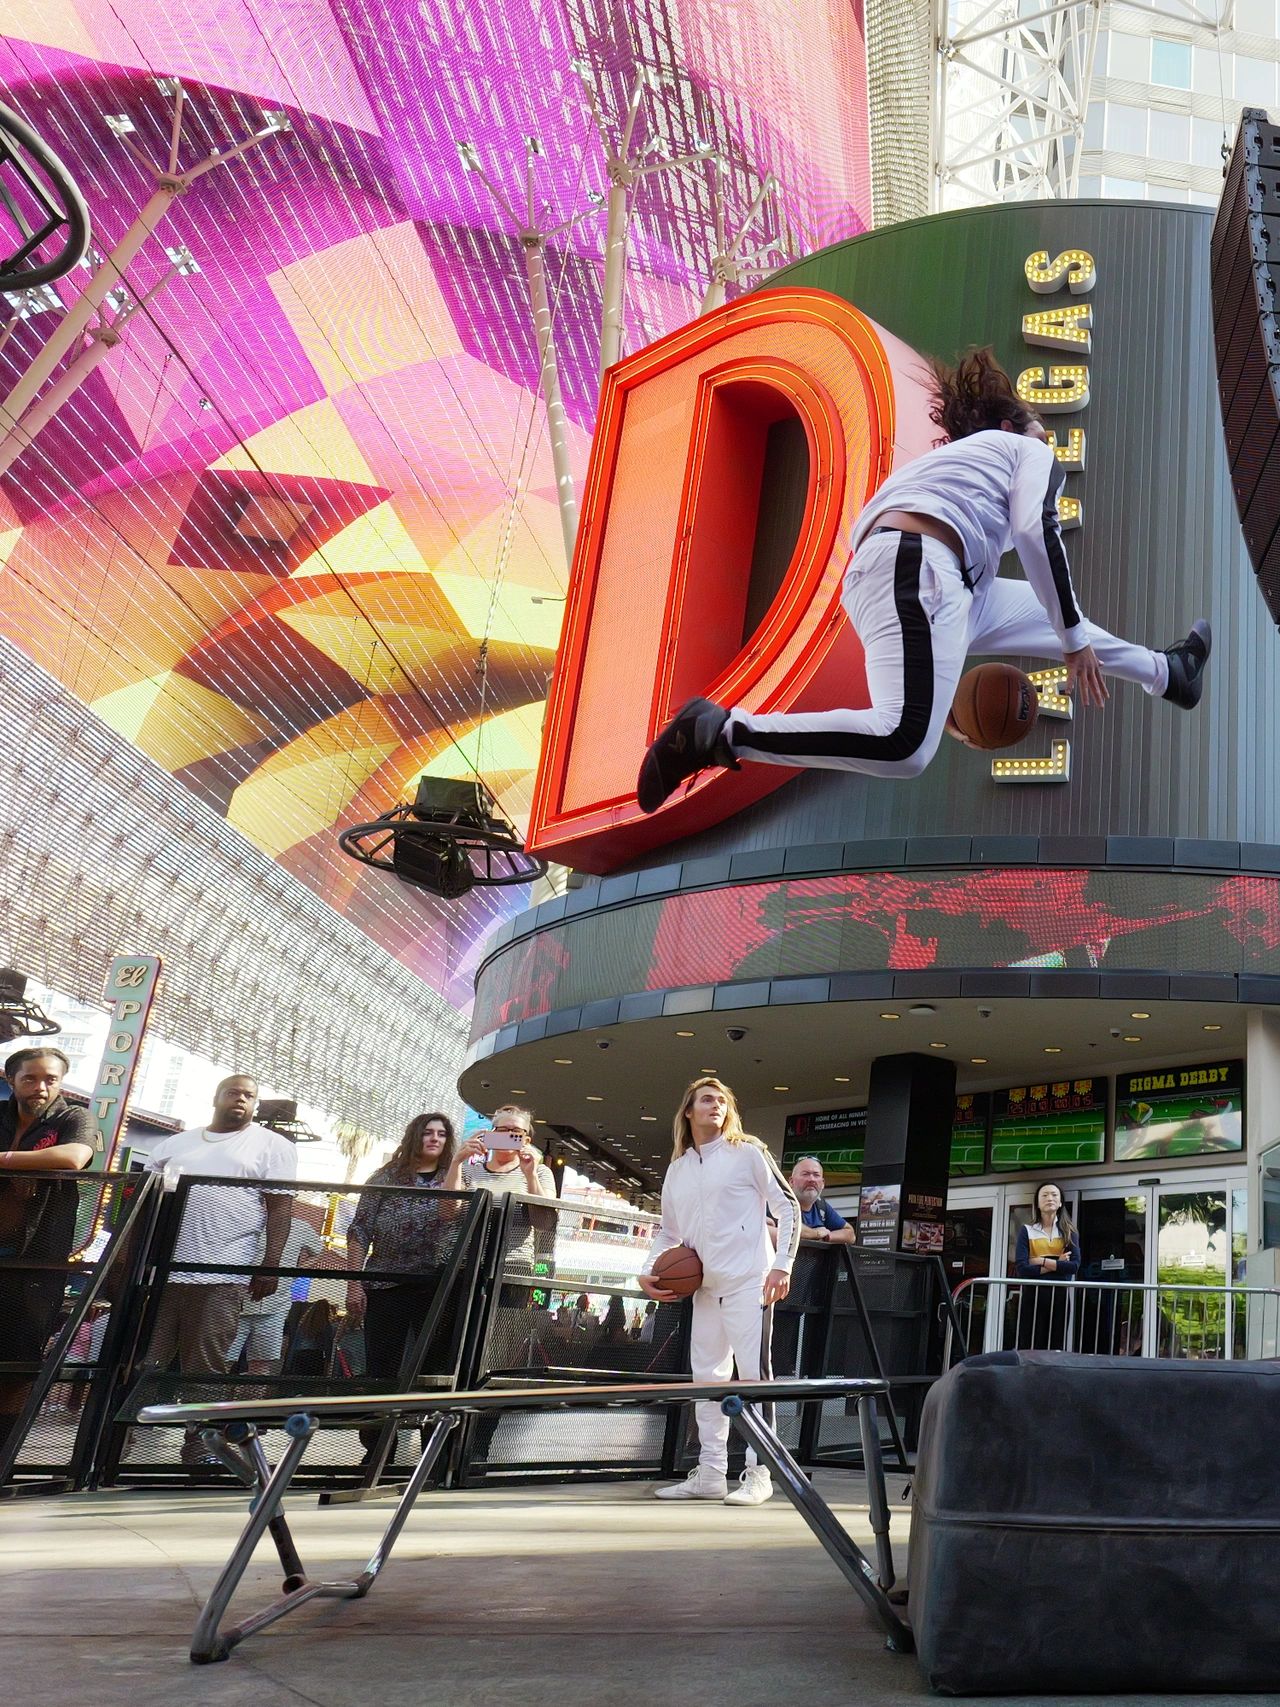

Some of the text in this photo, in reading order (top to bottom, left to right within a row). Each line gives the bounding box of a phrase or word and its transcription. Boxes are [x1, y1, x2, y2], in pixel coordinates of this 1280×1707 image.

[1016, 248, 1097, 530] EGAS
[525, 286, 905, 862] D
[113, 965, 148, 988] El
[1129, 1066, 1229, 1093] SIGMA DERBY
